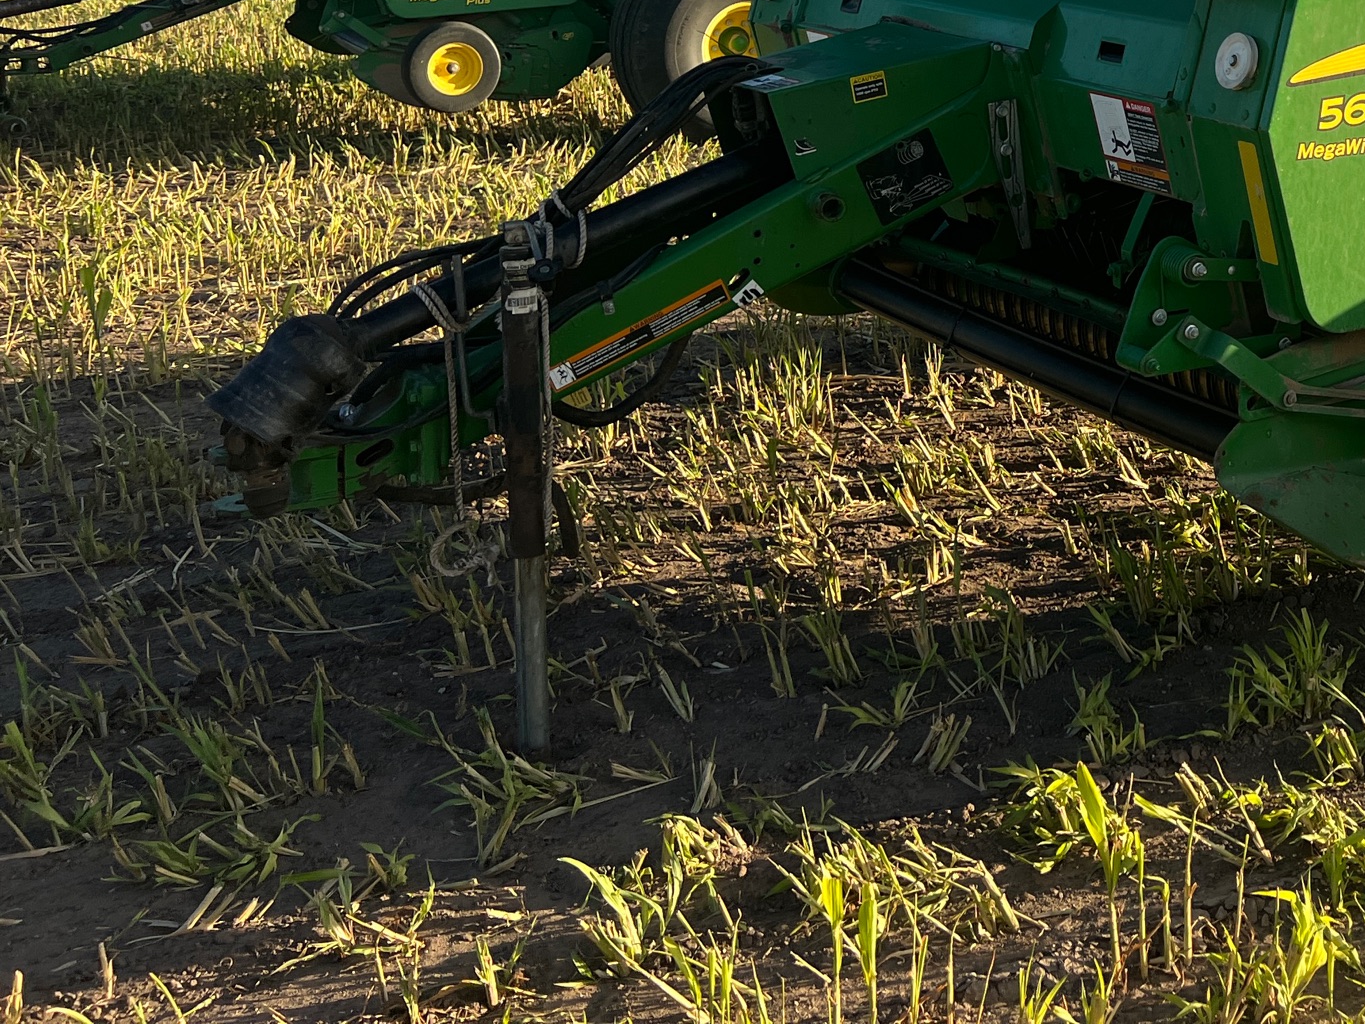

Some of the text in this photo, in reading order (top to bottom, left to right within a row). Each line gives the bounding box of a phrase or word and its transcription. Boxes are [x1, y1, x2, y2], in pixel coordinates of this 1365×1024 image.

[857, 72, 883, 83] CAUTION
[1130, 103, 1152, 113] DANGER
[634, 311, 664, 330] WARNING
